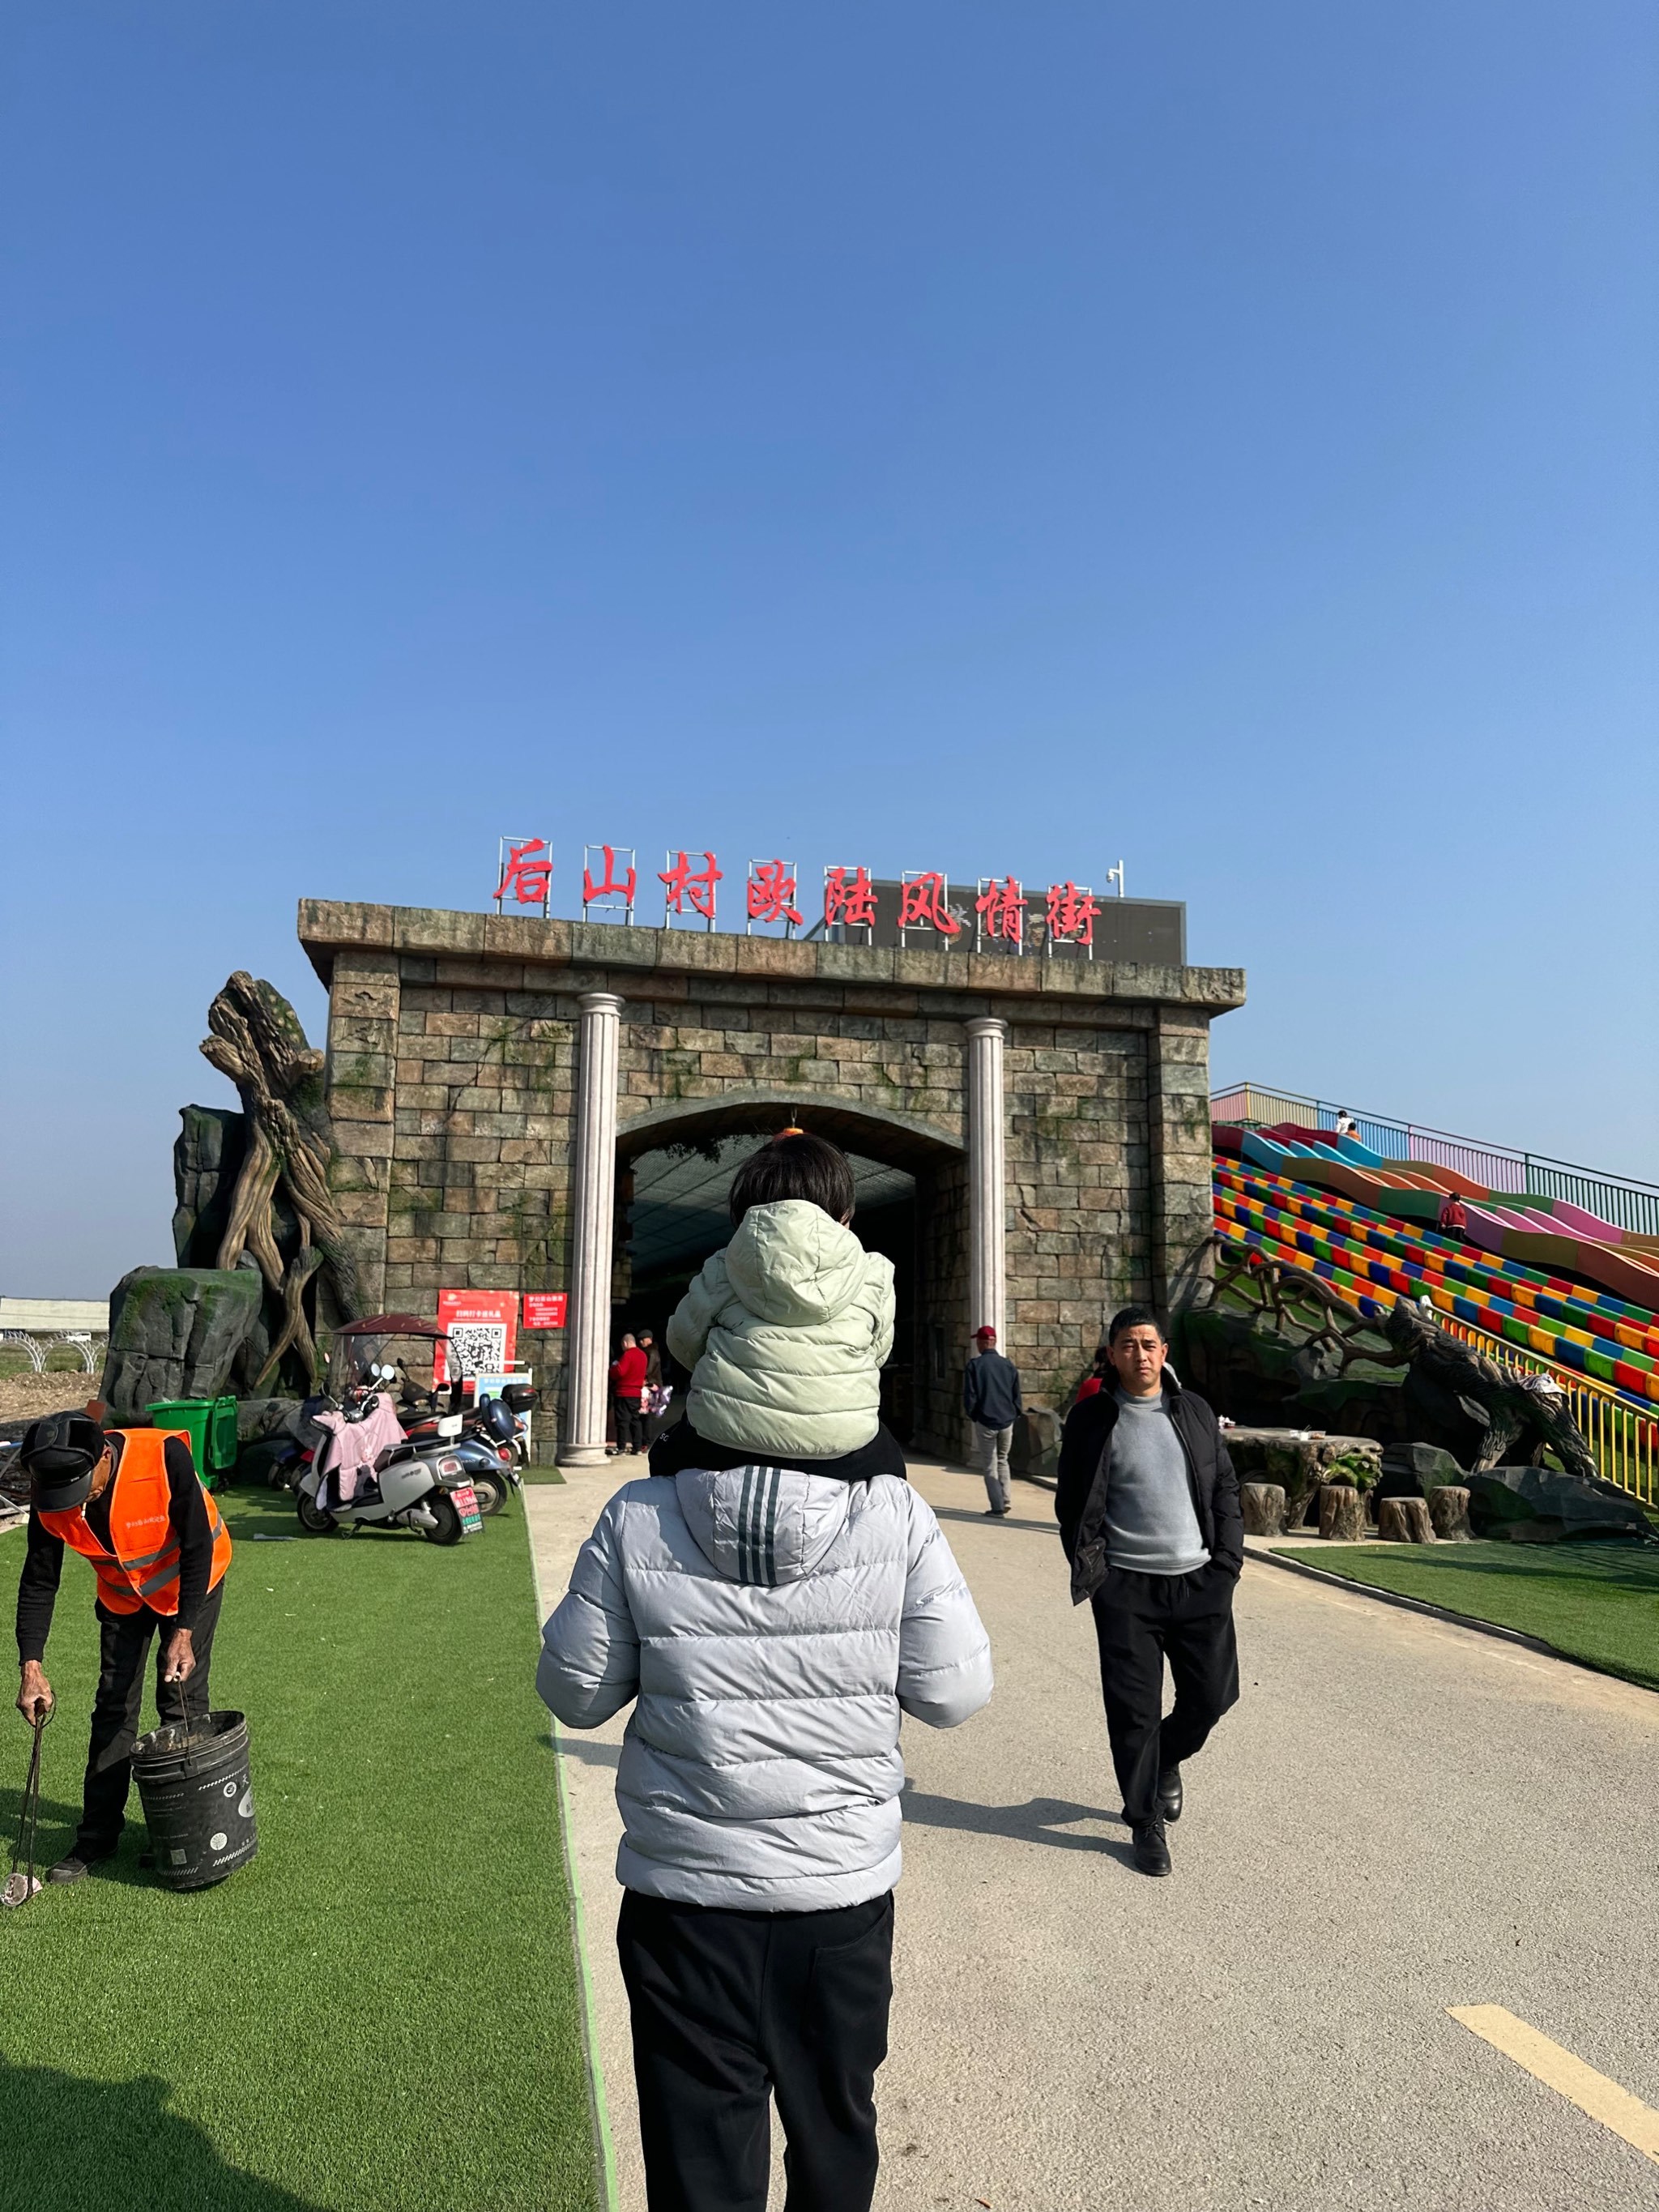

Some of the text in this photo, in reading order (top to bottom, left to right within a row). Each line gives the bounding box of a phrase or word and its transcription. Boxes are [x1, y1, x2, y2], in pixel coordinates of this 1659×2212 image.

[494, 838, 1101, 945] 后山村欧陆风情街
